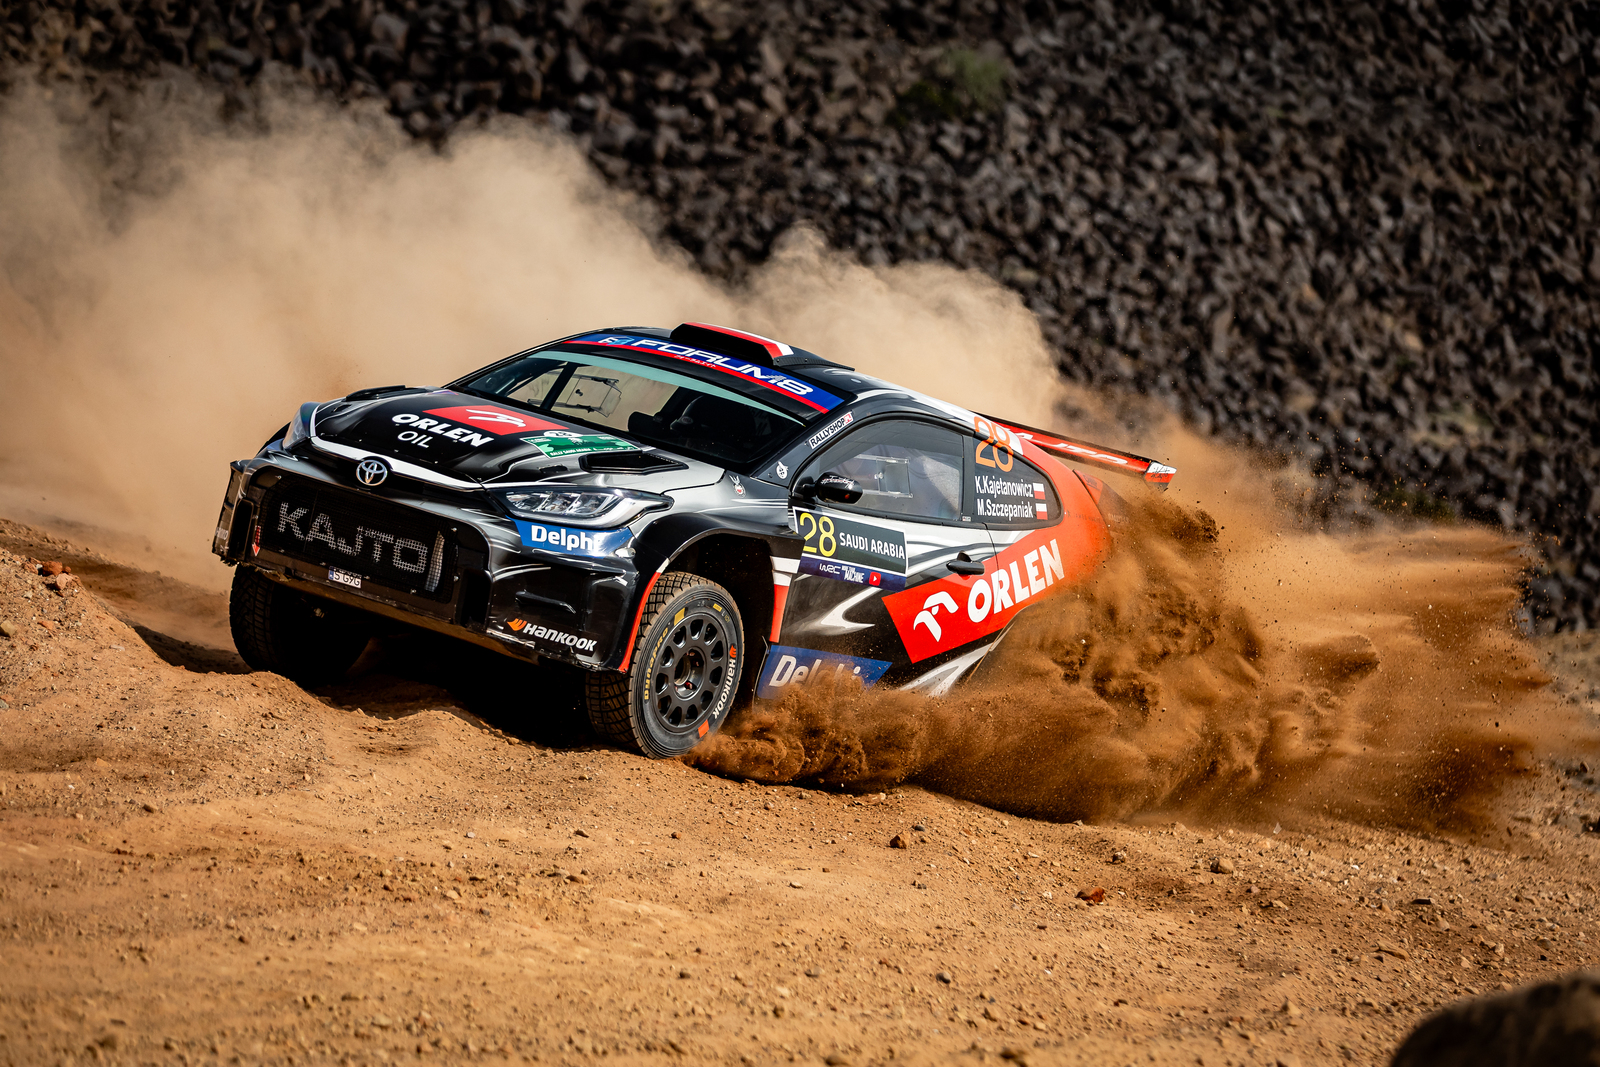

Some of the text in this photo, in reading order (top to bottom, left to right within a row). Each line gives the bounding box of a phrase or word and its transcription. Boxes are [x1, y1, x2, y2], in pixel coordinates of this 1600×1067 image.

[631, 338, 814, 396] FORUM8
[391, 413, 494, 448] ORLEN
[397, 430, 435, 448] OIL
[810, 417, 846, 447] RALLYSHOP
[974, 416, 1014, 473] 28
[974, 475, 1034, 500] K.Kajetanowicz
[977, 498, 1034, 521] M.Szczepaniak
[277, 501, 428, 574] KAJTO
[799, 512, 905, 560] 28 SAUDI ARABIA
[967, 538, 1066, 624] ORLEN
